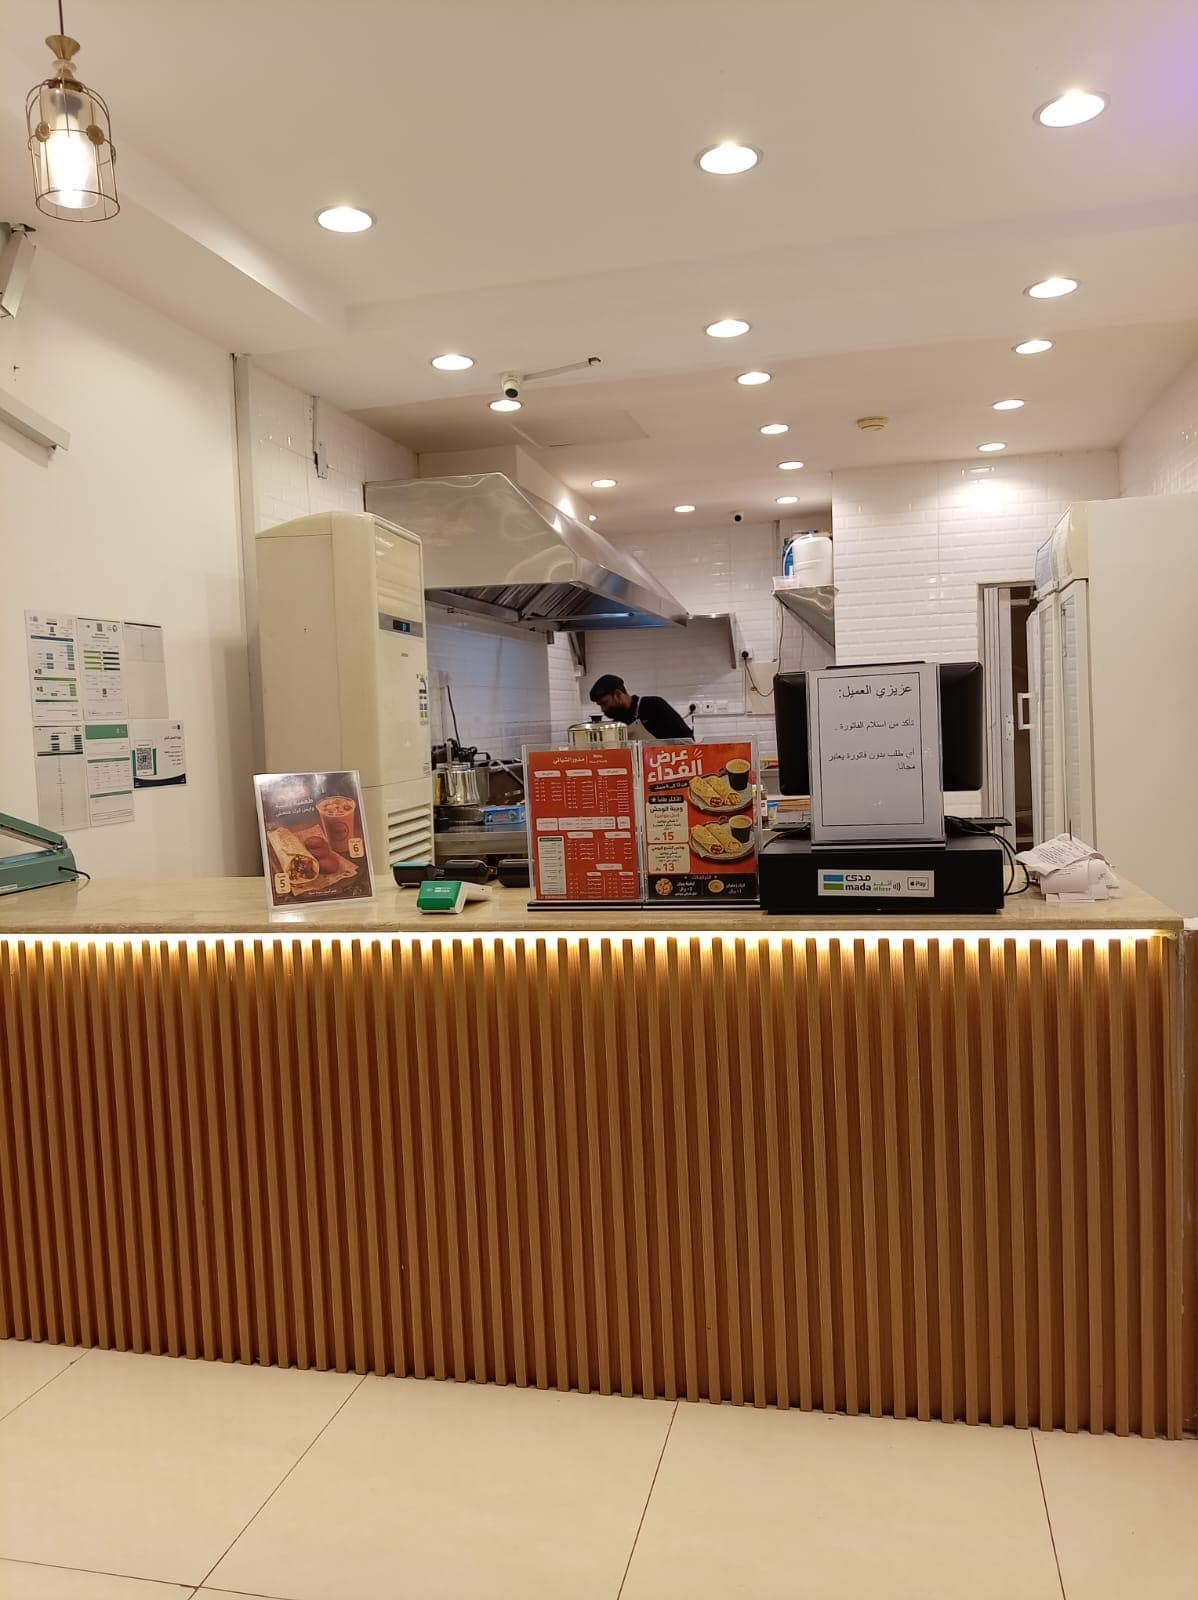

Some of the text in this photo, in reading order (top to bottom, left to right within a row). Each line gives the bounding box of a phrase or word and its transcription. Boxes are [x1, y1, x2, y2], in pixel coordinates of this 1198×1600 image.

[839, 683, 912, 699] عزيزي العميل:
[866, 720, 886, 731] استلام
[901, 717, 914, 727] تأكد
[846, 751, 867, 761] فاتورة
[869, 752, 886, 760] بدون
[888, 749, 904, 758] طلب
[649, 749, 689, 769] عرض
[647, 758, 703, 783] الغداء
[662, 832, 674, 841] 15
[353, 843, 360, 852] 6
[662, 863, 674, 872] 13
[280, 879, 286, 888] 5
[845, 882, 872, 891] mada
[915, 880, 926, 888] Pay
